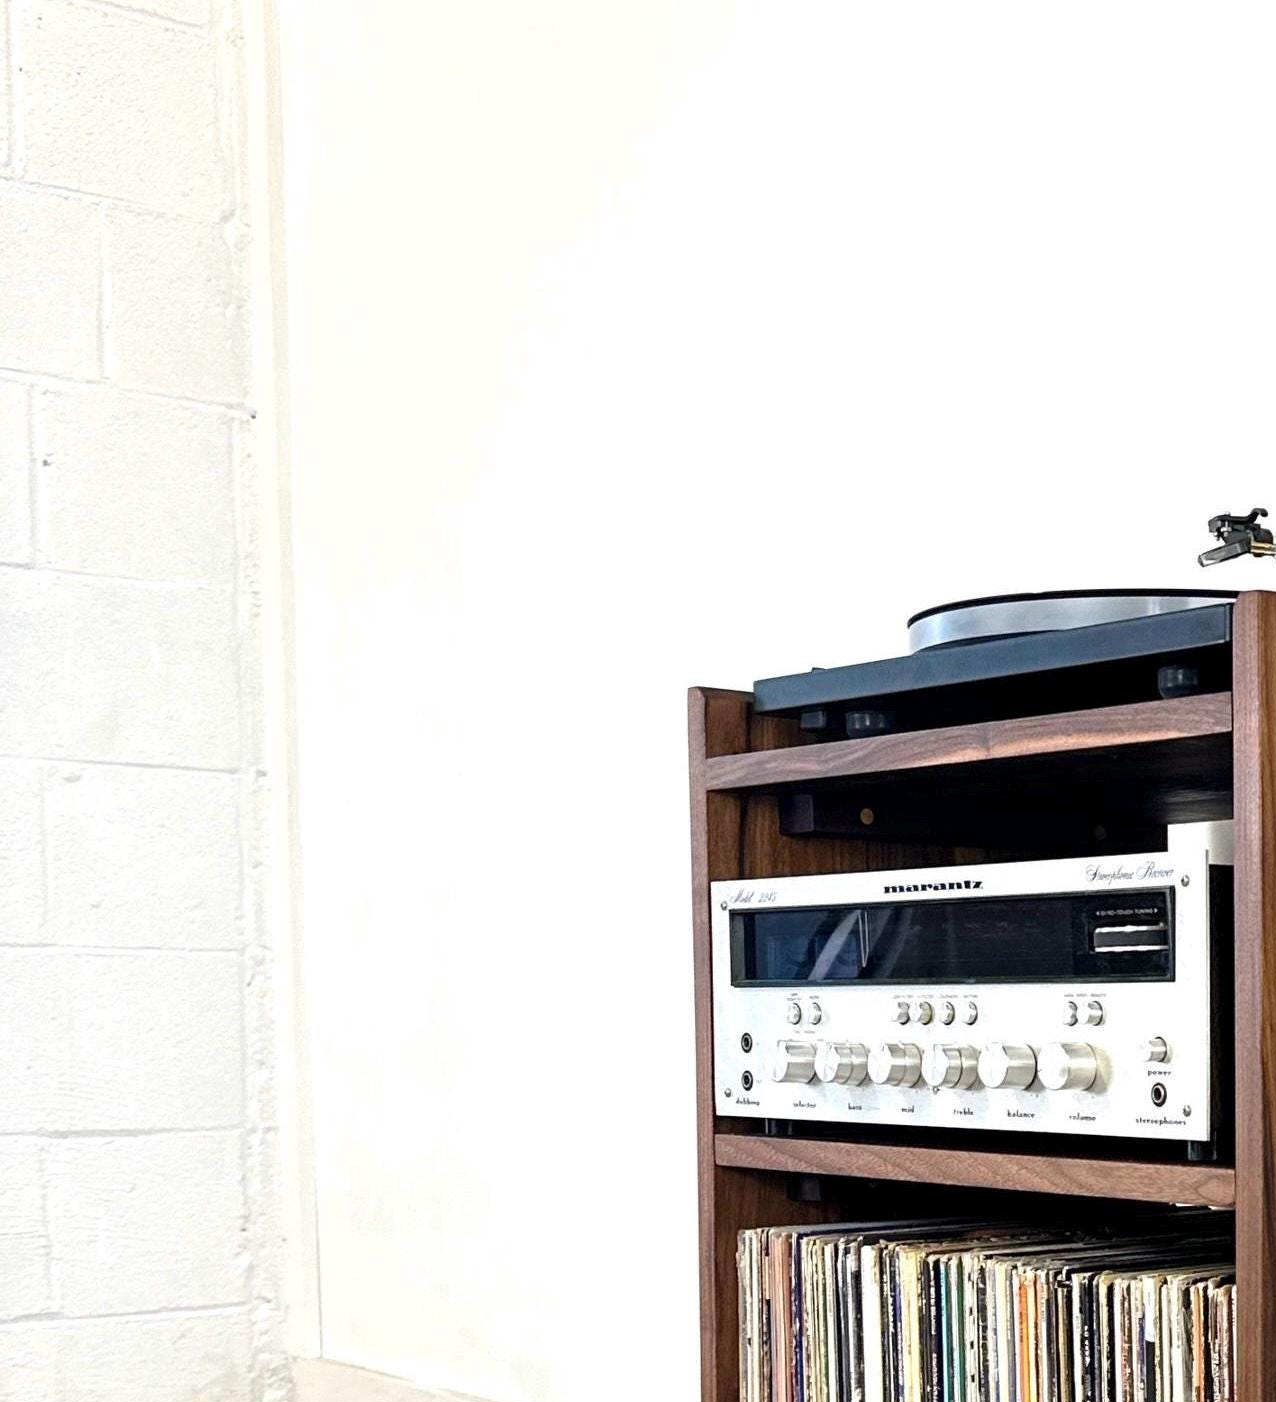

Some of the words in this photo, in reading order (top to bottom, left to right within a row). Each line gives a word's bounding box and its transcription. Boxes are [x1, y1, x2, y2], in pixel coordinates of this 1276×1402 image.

[884, 880, 983, 894] marantz
[848, 1103, 862, 1111] bass
[901, 1105, 915, 1113] mid
[953, 1108, 974, 1116] treble
[1007, 1110, 1035, 1118] balance
[1069, 1112, 1096, 1121] volume
[1135, 1116, 1186, 1126] stereophones
